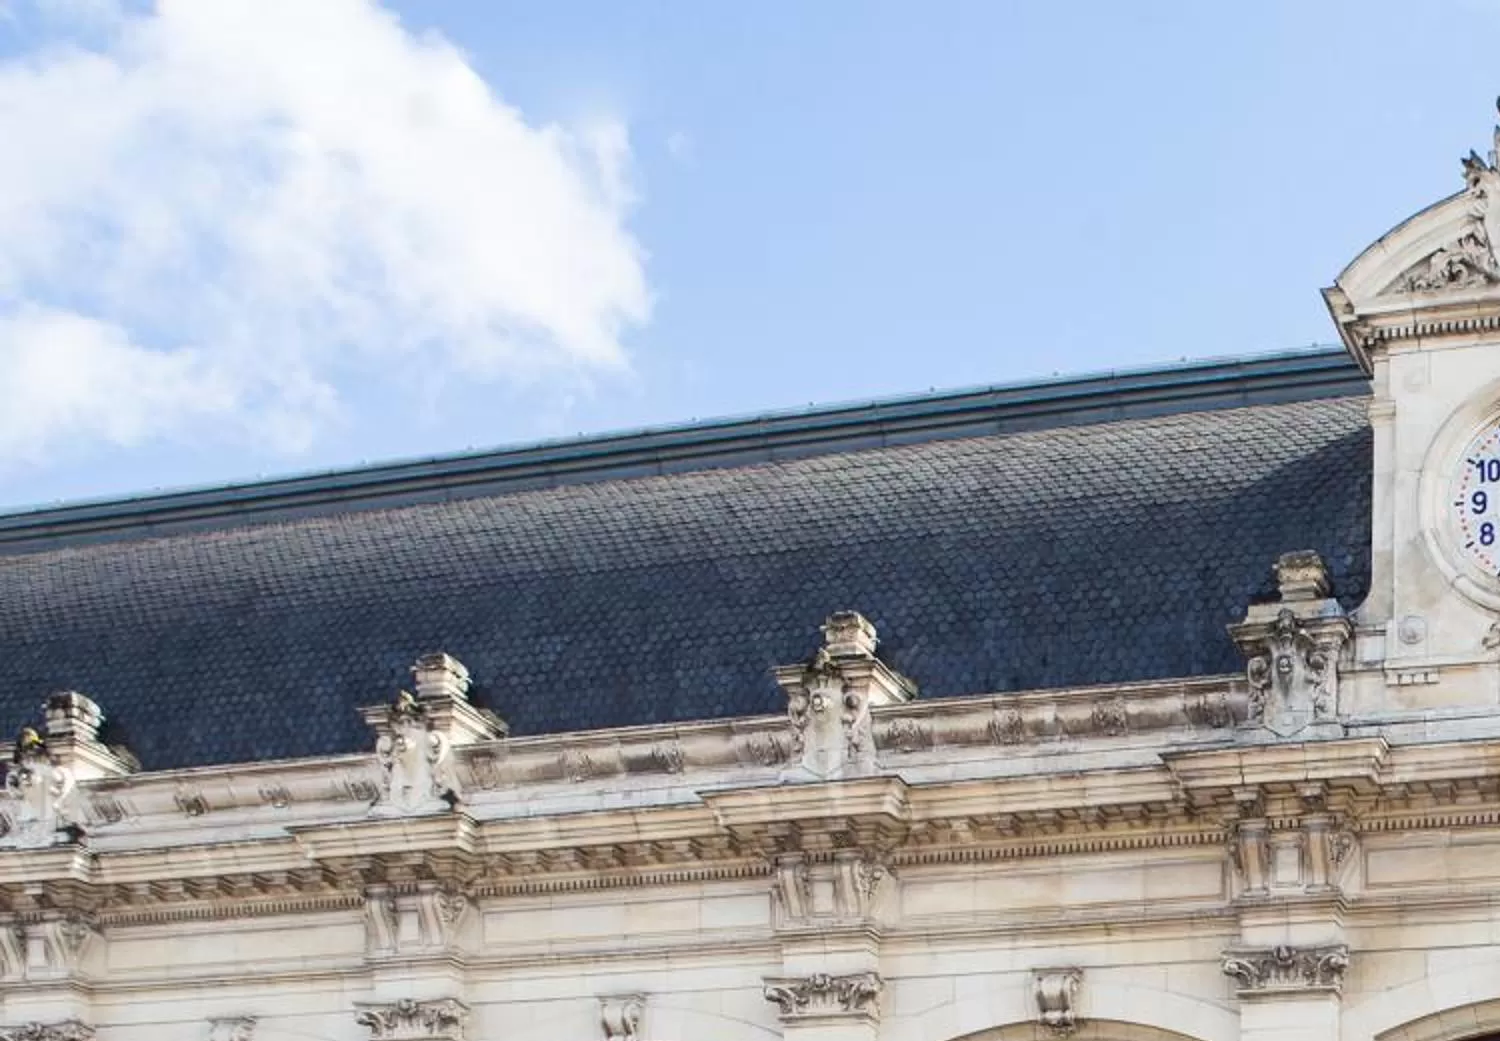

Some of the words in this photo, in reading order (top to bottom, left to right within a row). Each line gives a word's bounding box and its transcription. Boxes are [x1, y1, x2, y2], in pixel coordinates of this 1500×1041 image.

[1477, 459, 1500, 483] 10
[1471, 491, 1487, 514] 9
[1479, 522, 1495, 546] 8
